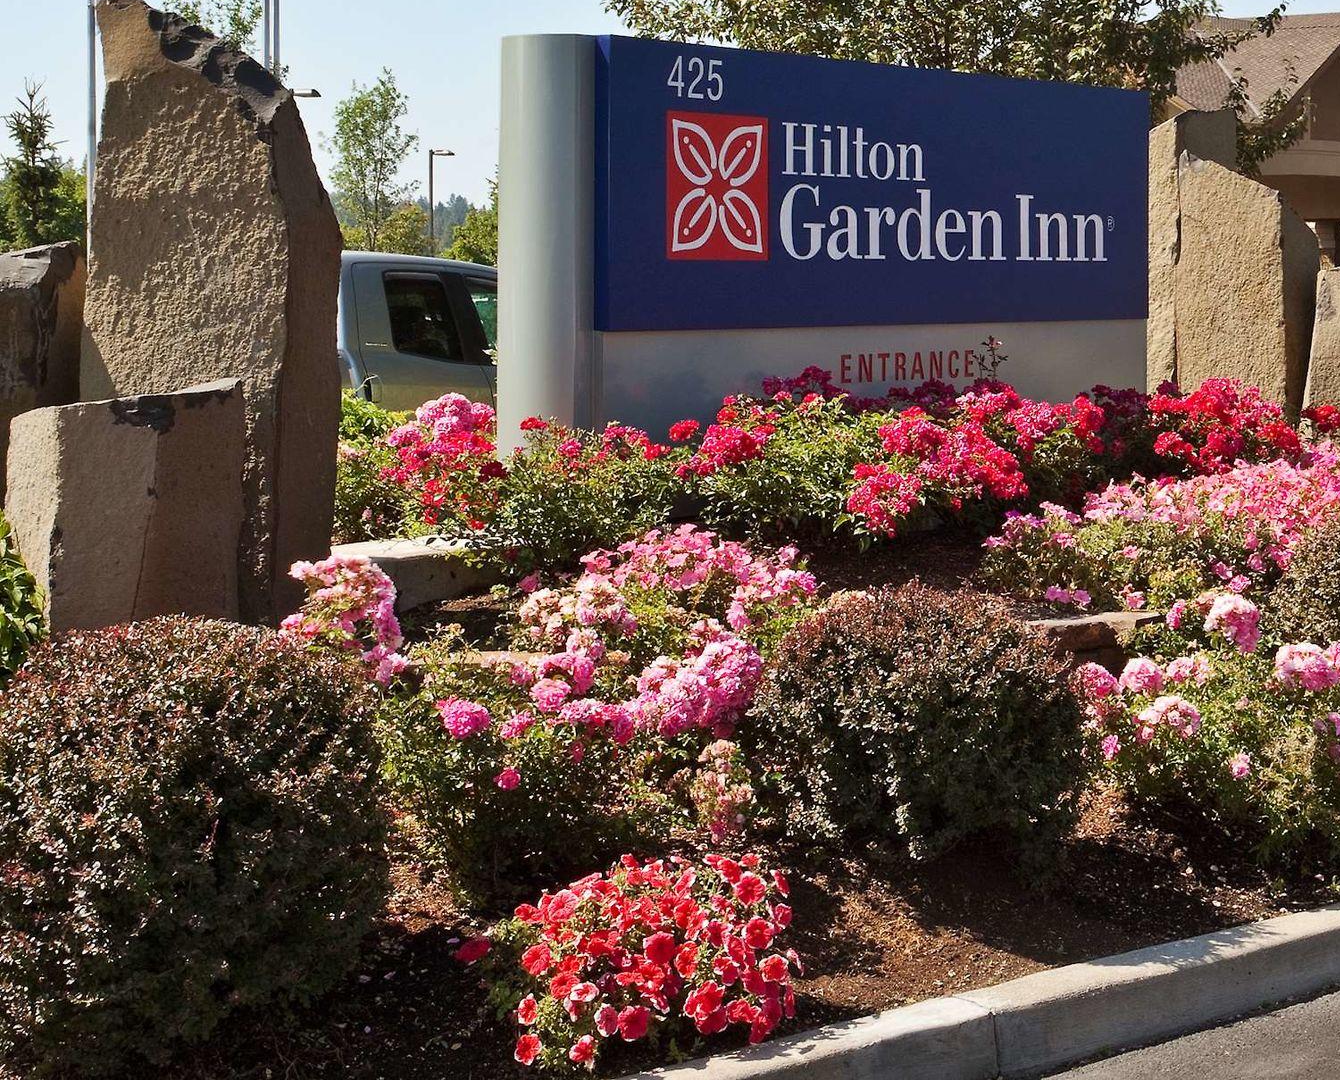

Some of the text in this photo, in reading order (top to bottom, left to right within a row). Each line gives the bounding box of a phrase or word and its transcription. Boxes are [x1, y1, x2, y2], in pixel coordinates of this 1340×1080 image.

[668, 56, 724, 101] 425
[781, 122, 926, 181] Hilton
[779, 183, 1007, 261] Garden
[840, 350, 974, 384] ENTRANCE
